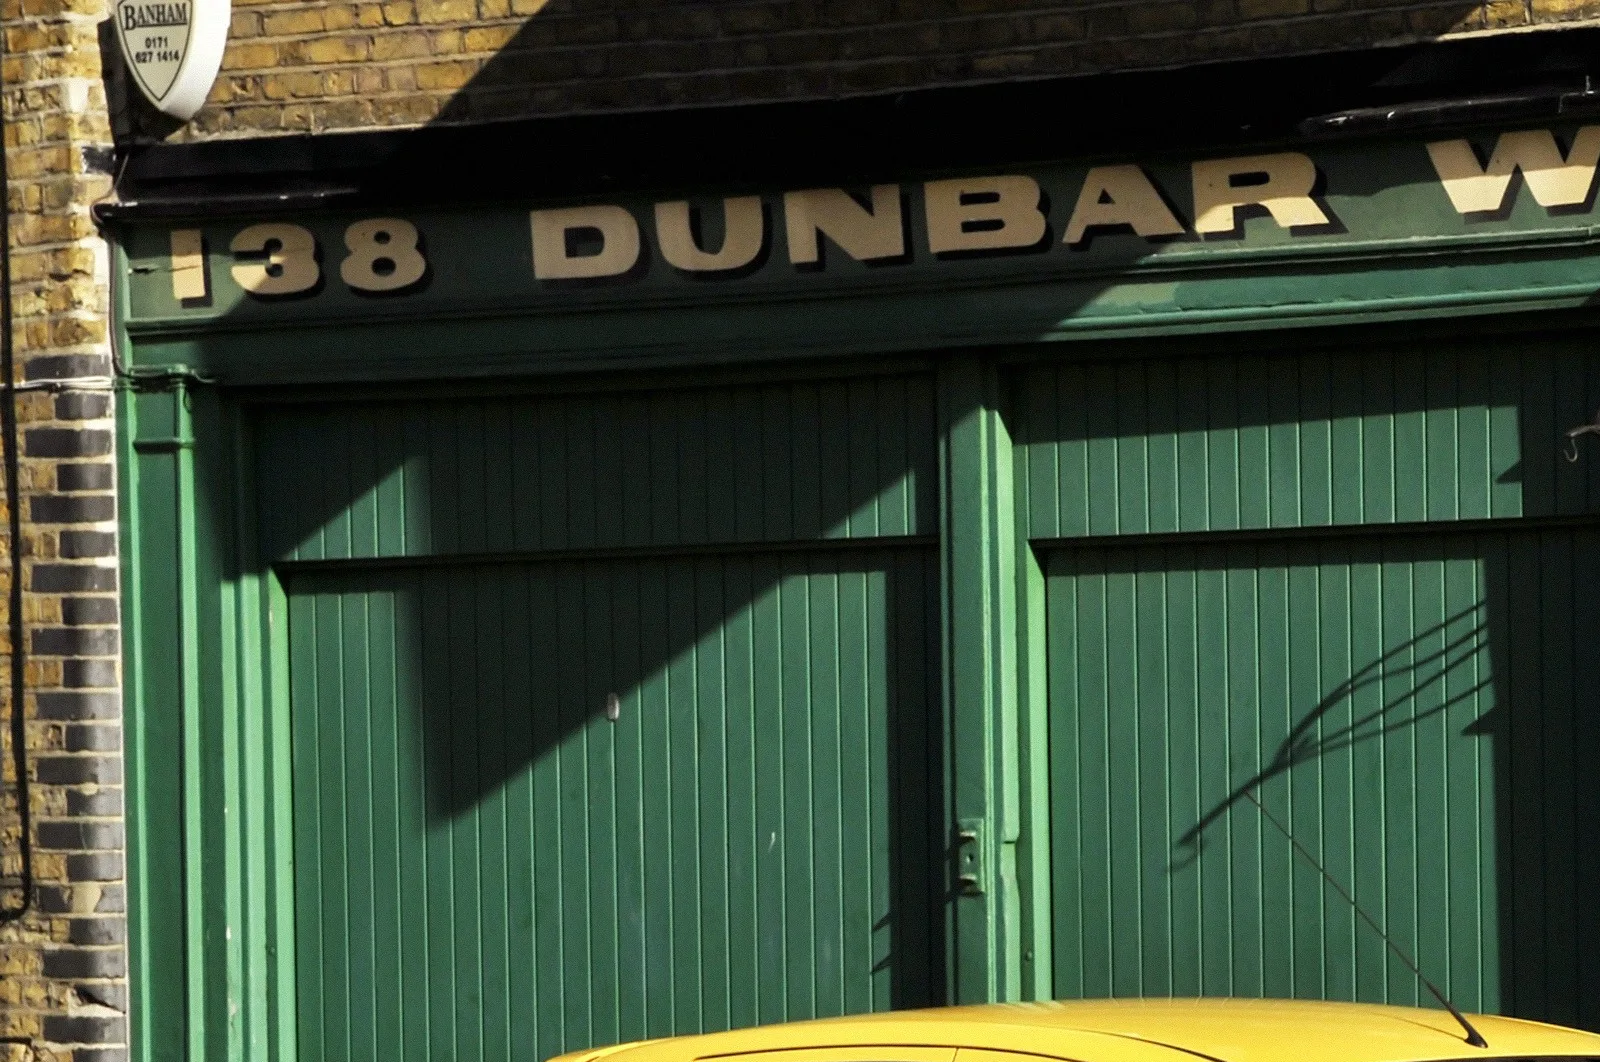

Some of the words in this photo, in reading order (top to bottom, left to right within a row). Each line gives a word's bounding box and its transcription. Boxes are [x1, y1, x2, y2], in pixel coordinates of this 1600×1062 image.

[124, 2, 188, 31] BANHAM
[145, 37, 168, 48] 0171
[135, 51, 153, 63] 627
[157, 50, 179, 62] 1414
[170, 217, 426, 299] 138
[530, 151, 1330, 281] DUNBAR
